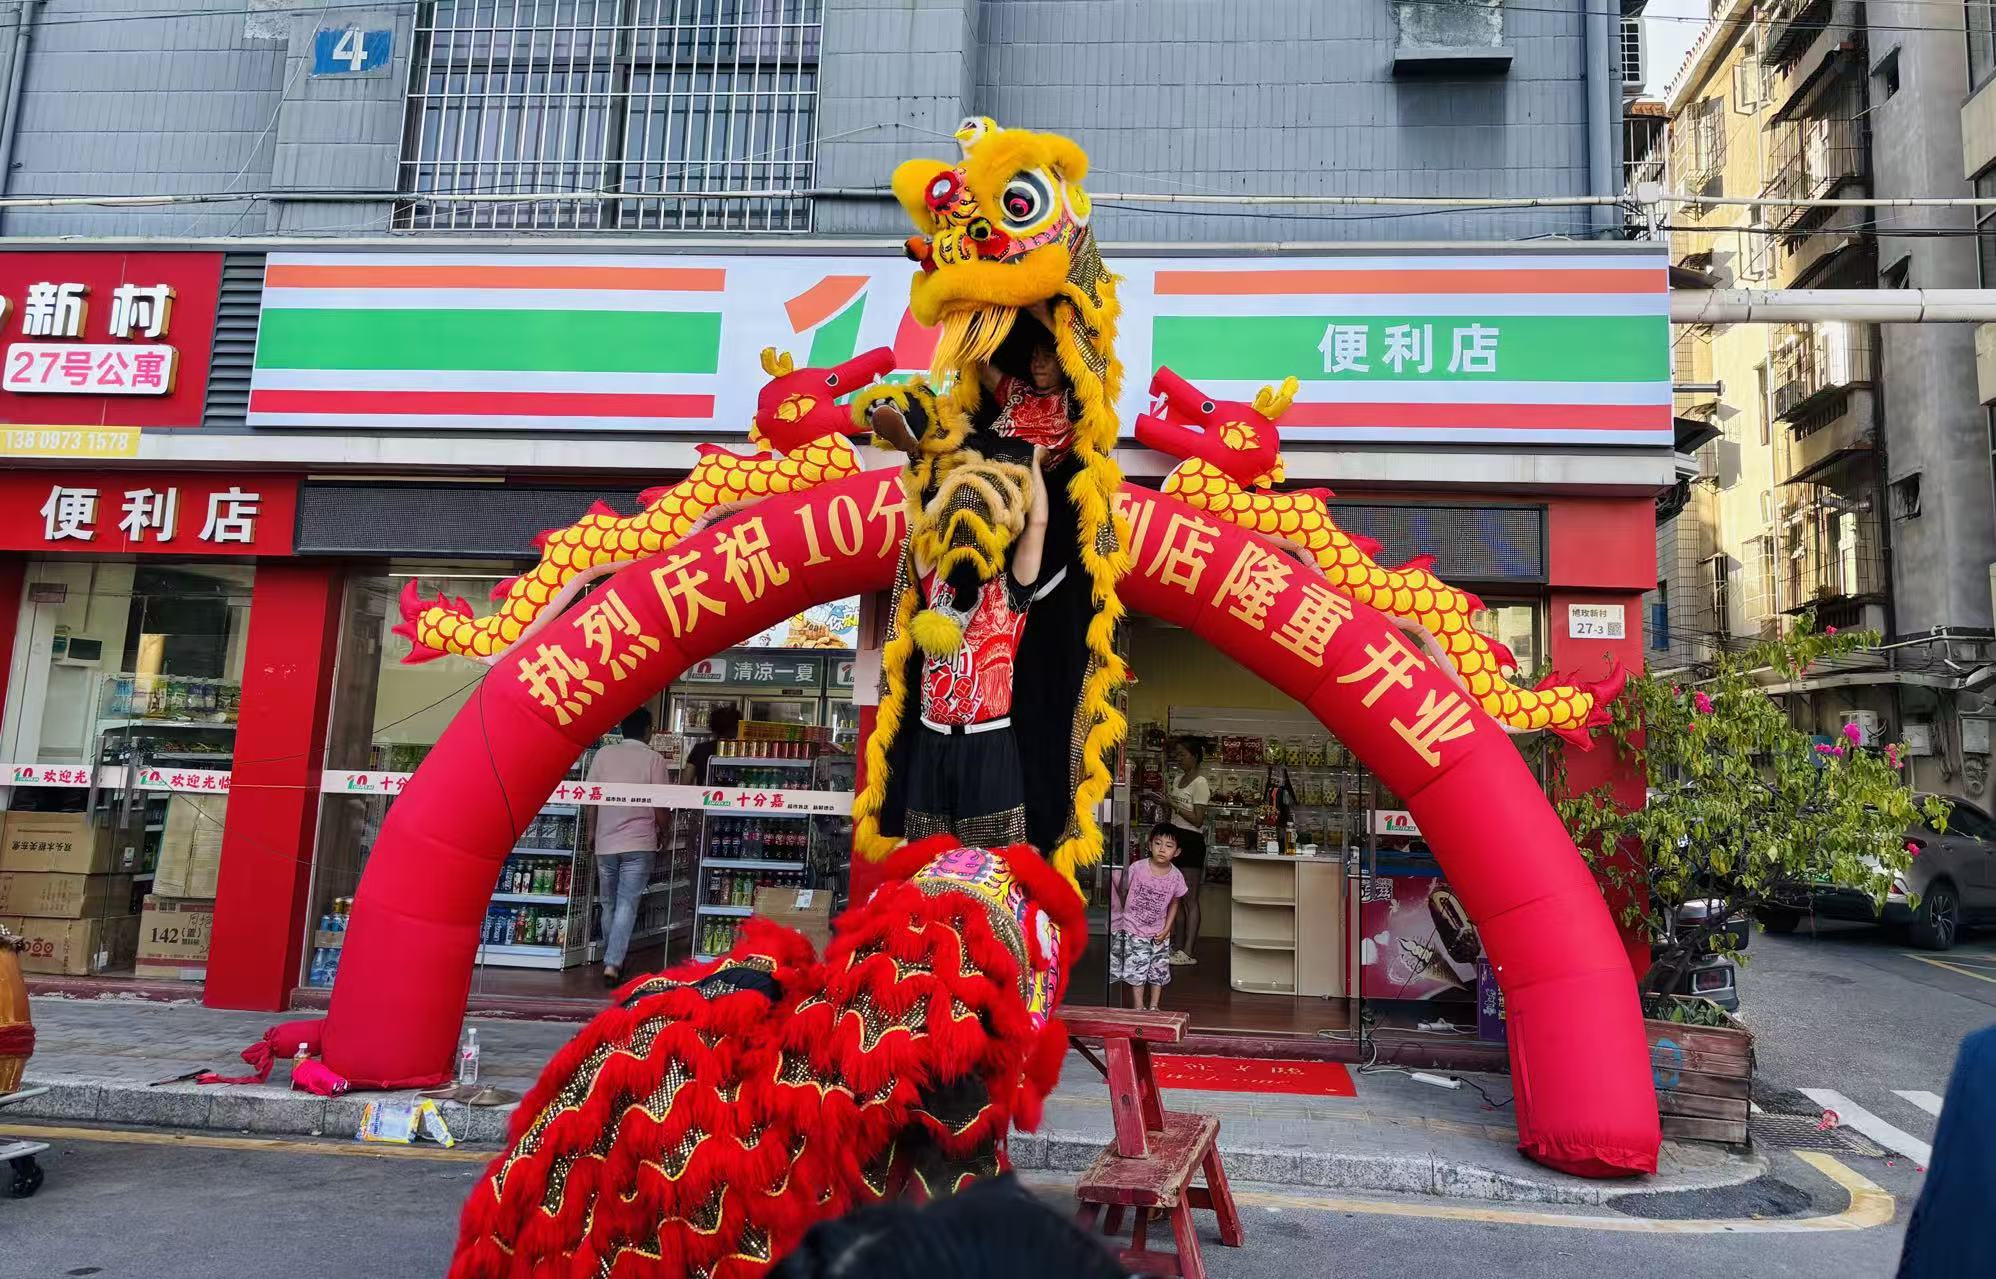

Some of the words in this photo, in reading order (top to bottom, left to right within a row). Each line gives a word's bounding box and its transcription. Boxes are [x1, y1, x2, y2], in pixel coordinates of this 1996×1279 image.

[333, 26, 368, 70] 4
[0, 282, 171, 338] 新村
[1317, 323, 1500, 374] 便利店
[10, 350, 165, 388] 27号公寓
[5, 430, 35, 449] 138
[40, 485, 260, 543] 便利店
[1577, 623, 1604, 634] 27-3
[733, 661, 814, 682] 清凉一夏
[556, 785, 603, 800] 十分嘉
[736, 792, 785, 808] 十分嘉
[151, 928, 179, 943] 142
